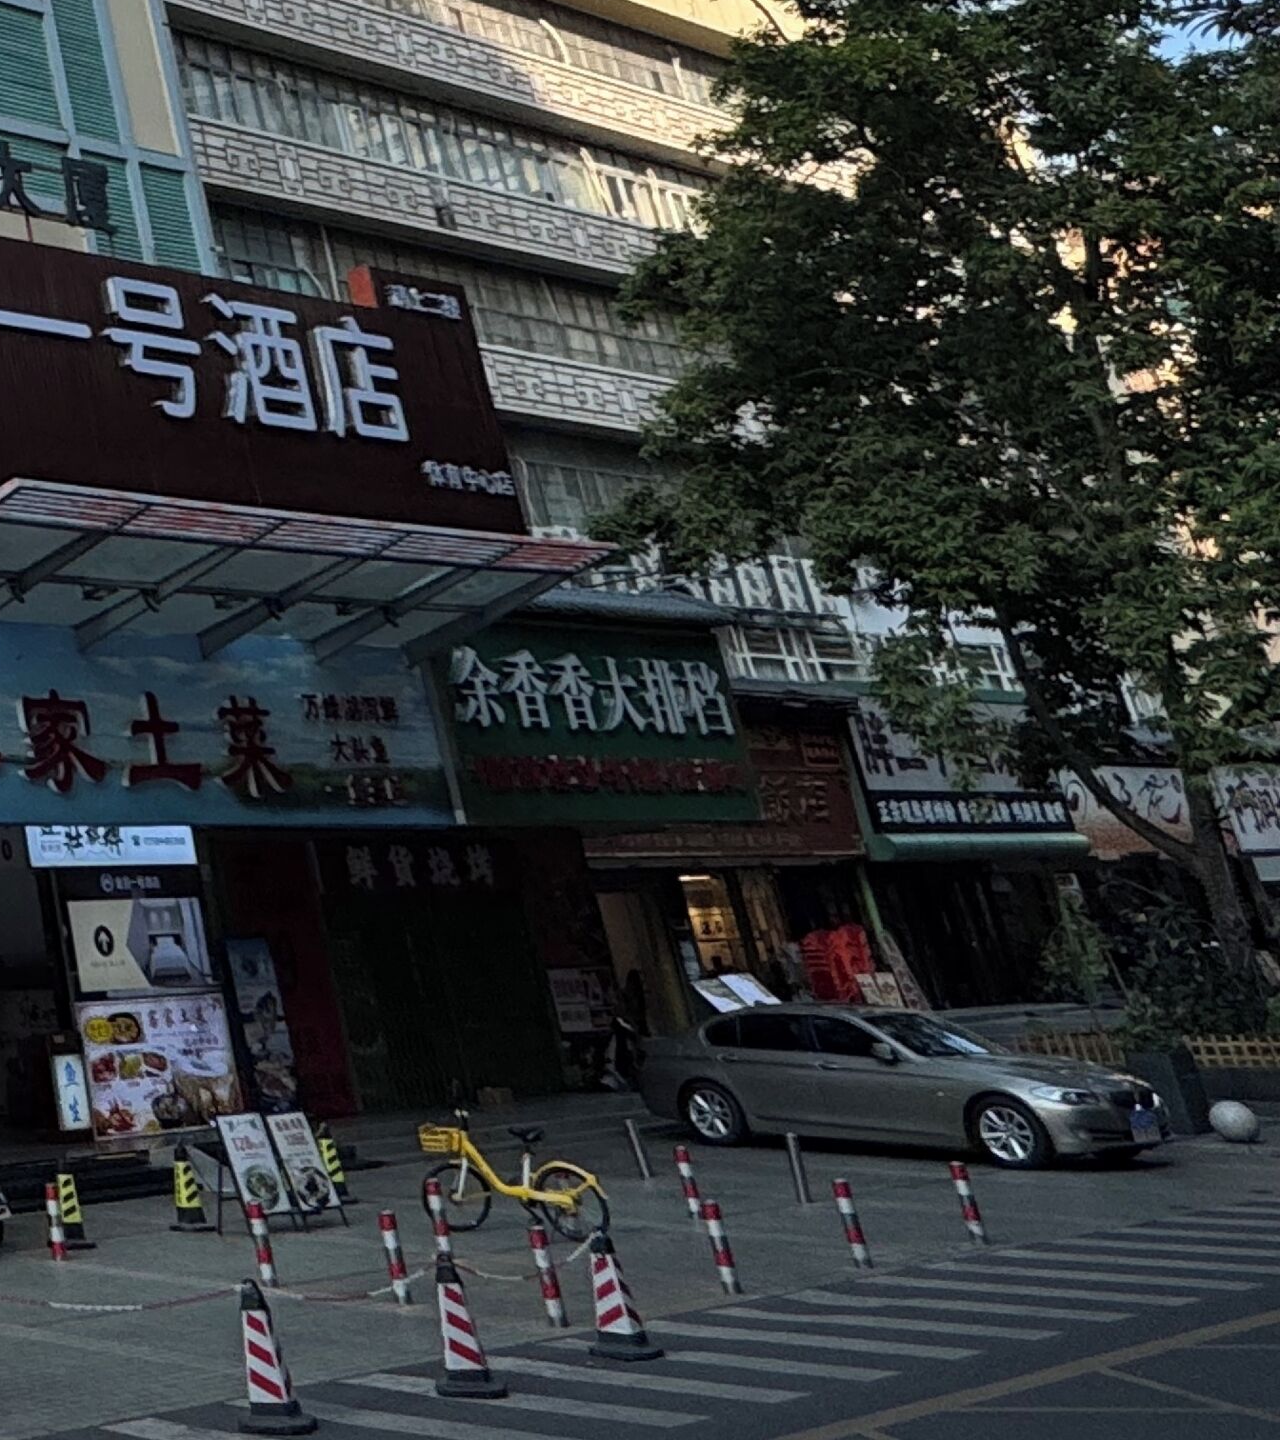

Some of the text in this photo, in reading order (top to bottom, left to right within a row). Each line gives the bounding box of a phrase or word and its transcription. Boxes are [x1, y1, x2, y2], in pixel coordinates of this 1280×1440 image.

[449, 645, 736, 736] 余香香大排档
